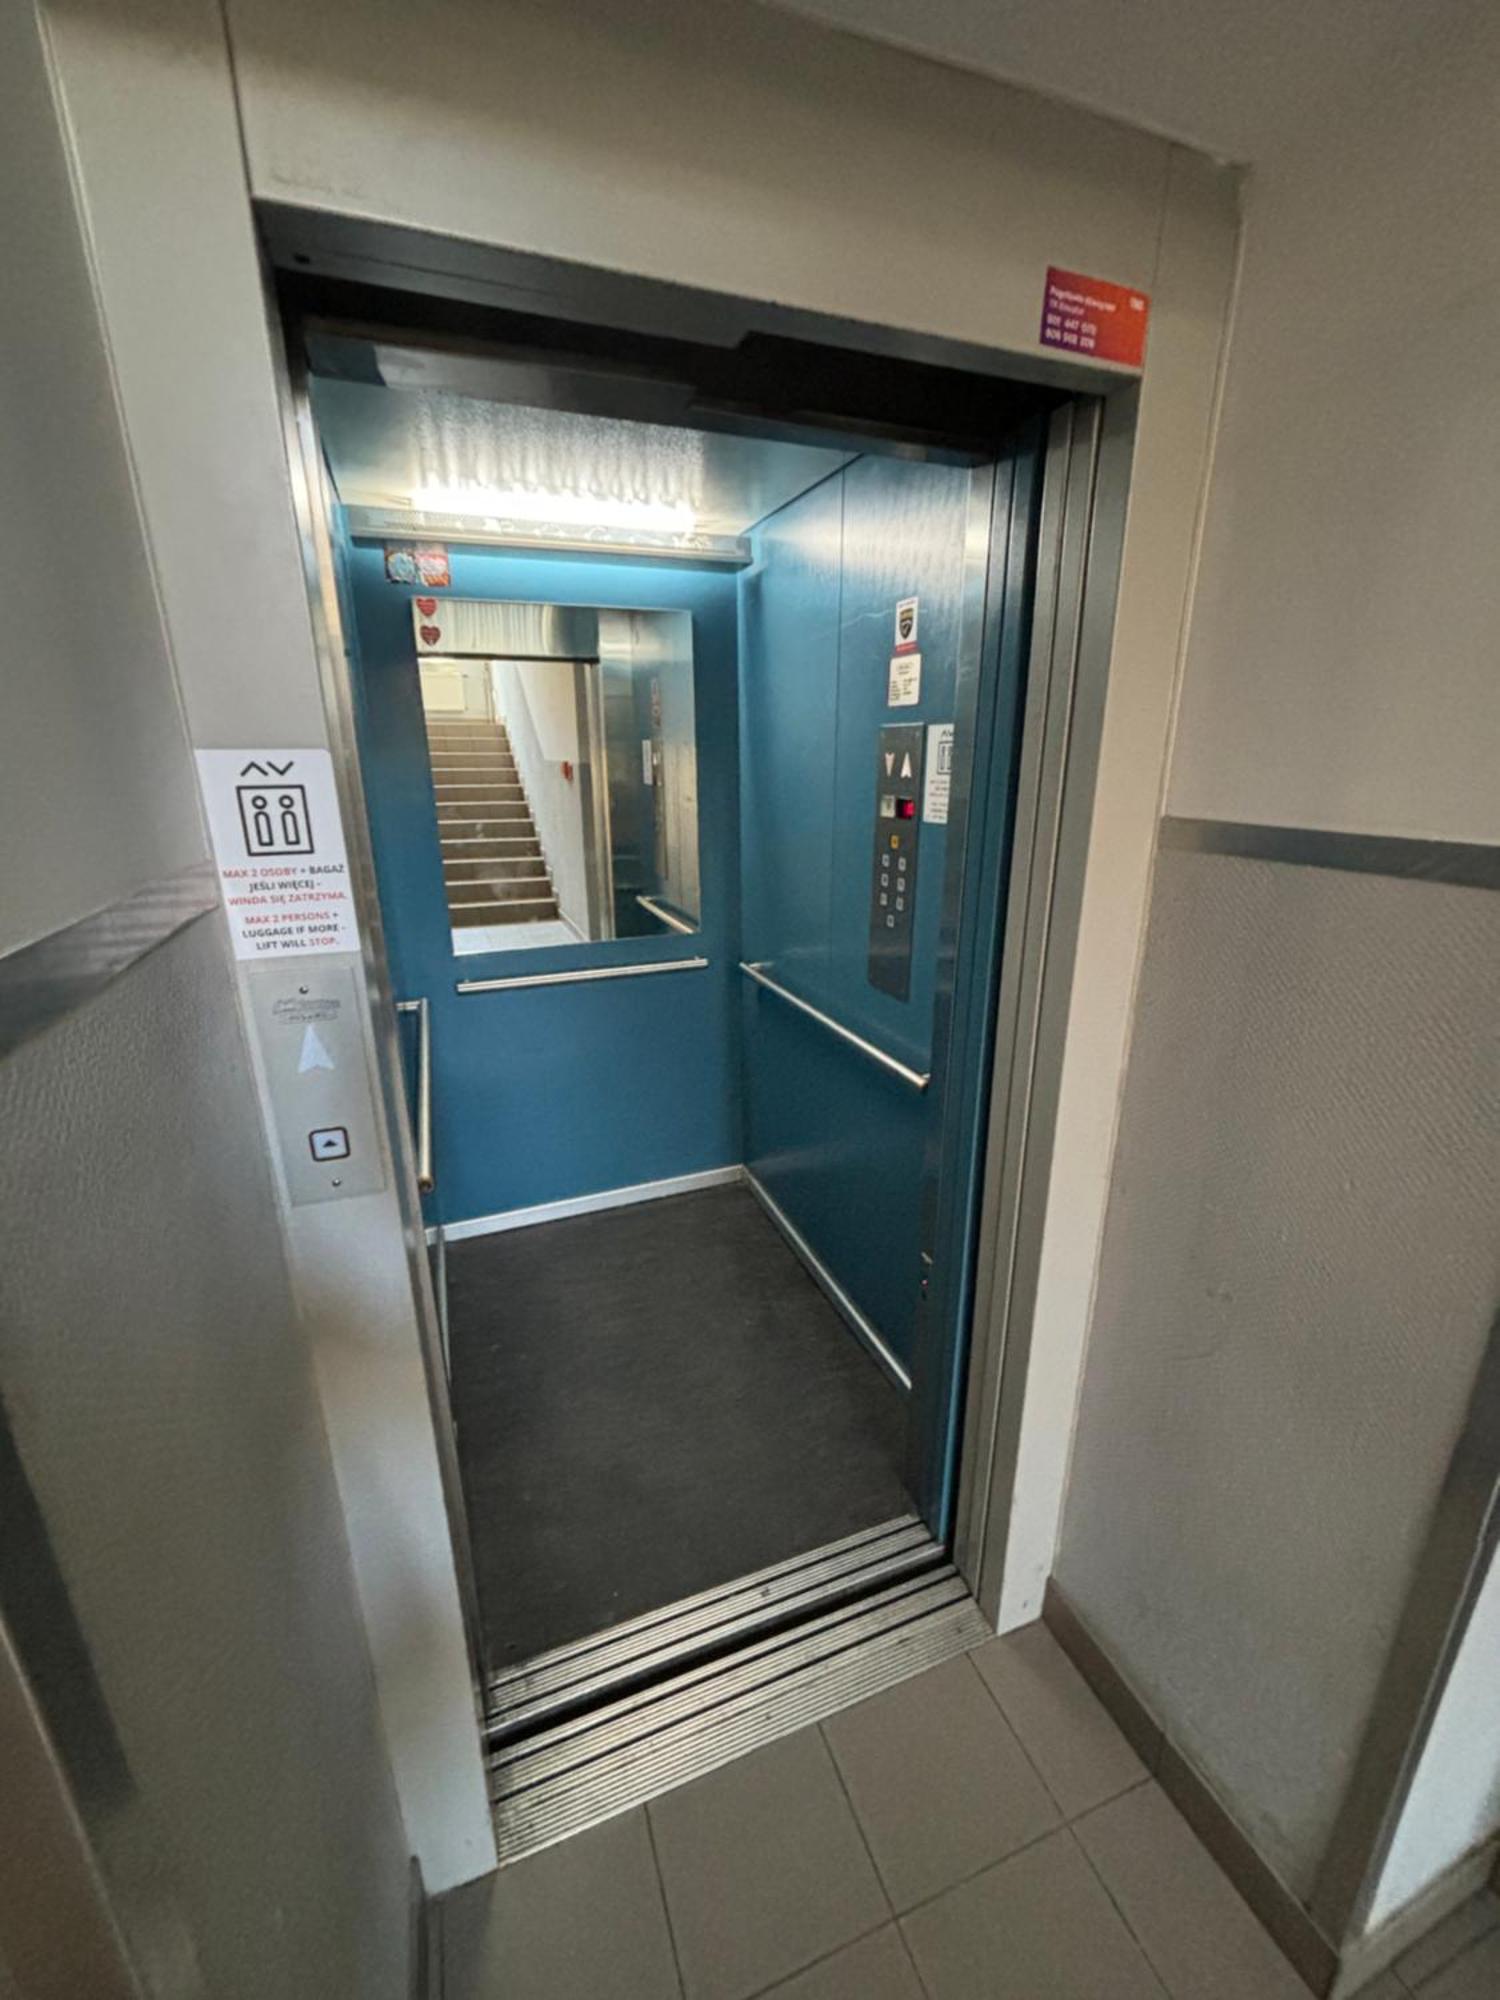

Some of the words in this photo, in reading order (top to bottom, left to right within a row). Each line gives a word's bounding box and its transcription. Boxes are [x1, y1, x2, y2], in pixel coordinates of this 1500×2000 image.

[223, 867, 248, 878] MAX
[251, 867, 258, 877] 2
[259, 866, 297, 877] OSOBY
[228, 896, 267, 906] WINDA
[270, 894, 286, 905] SIĘ
[245, 914, 270, 924] MAX
[272, 914, 279, 923] 2
[282, 911, 330, 922] PERSONS
[242, 926, 293, 938] LUGGAGE
[296, 925, 305, 934] IF
[308, 924, 339, 933] MORE
[256, 941, 277, 950] LIFT
[280, 939, 307, 949] WILL
